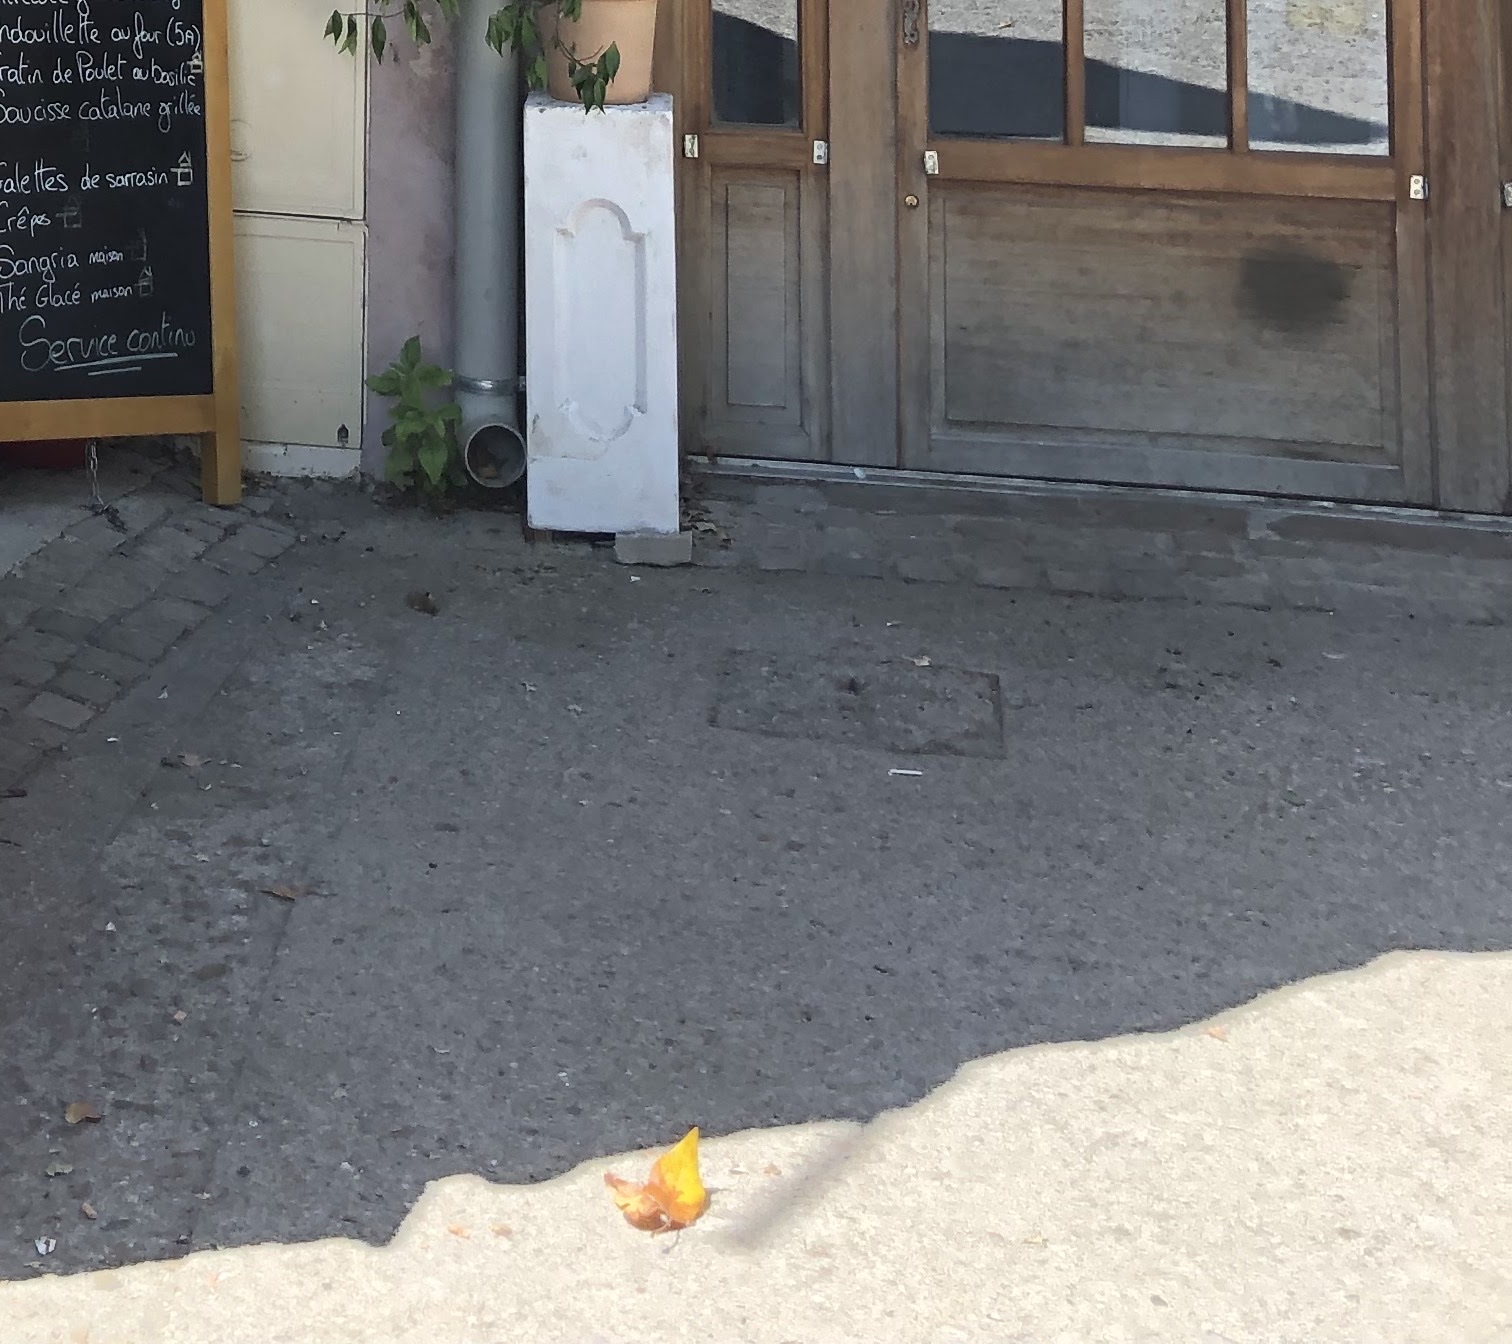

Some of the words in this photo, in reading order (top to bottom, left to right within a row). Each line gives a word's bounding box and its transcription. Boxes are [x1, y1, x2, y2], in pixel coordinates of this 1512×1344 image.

[111, 26, 131, 41] au
[132, 11, 162, 60] four
[166, 16, 202, 52] (5A)
[52, 57, 73, 84] de
[75, 50, 128, 84] Poulet
[132, 68, 149, 81] au
[151, 58, 196, 87] basilic
[79, 86, 151, 120] catalane
[158, 89, 202, 133] grillée
[81, 163, 100, 191] de
[105, 166, 169, 188] sarrasin
[88, 245, 124, 265] maison
[35, 280, 81, 308] Glacé
[90, 283, 133, 304] maison
[18, 315, 119, 372] Service
[126, 312, 196, 352] continu
